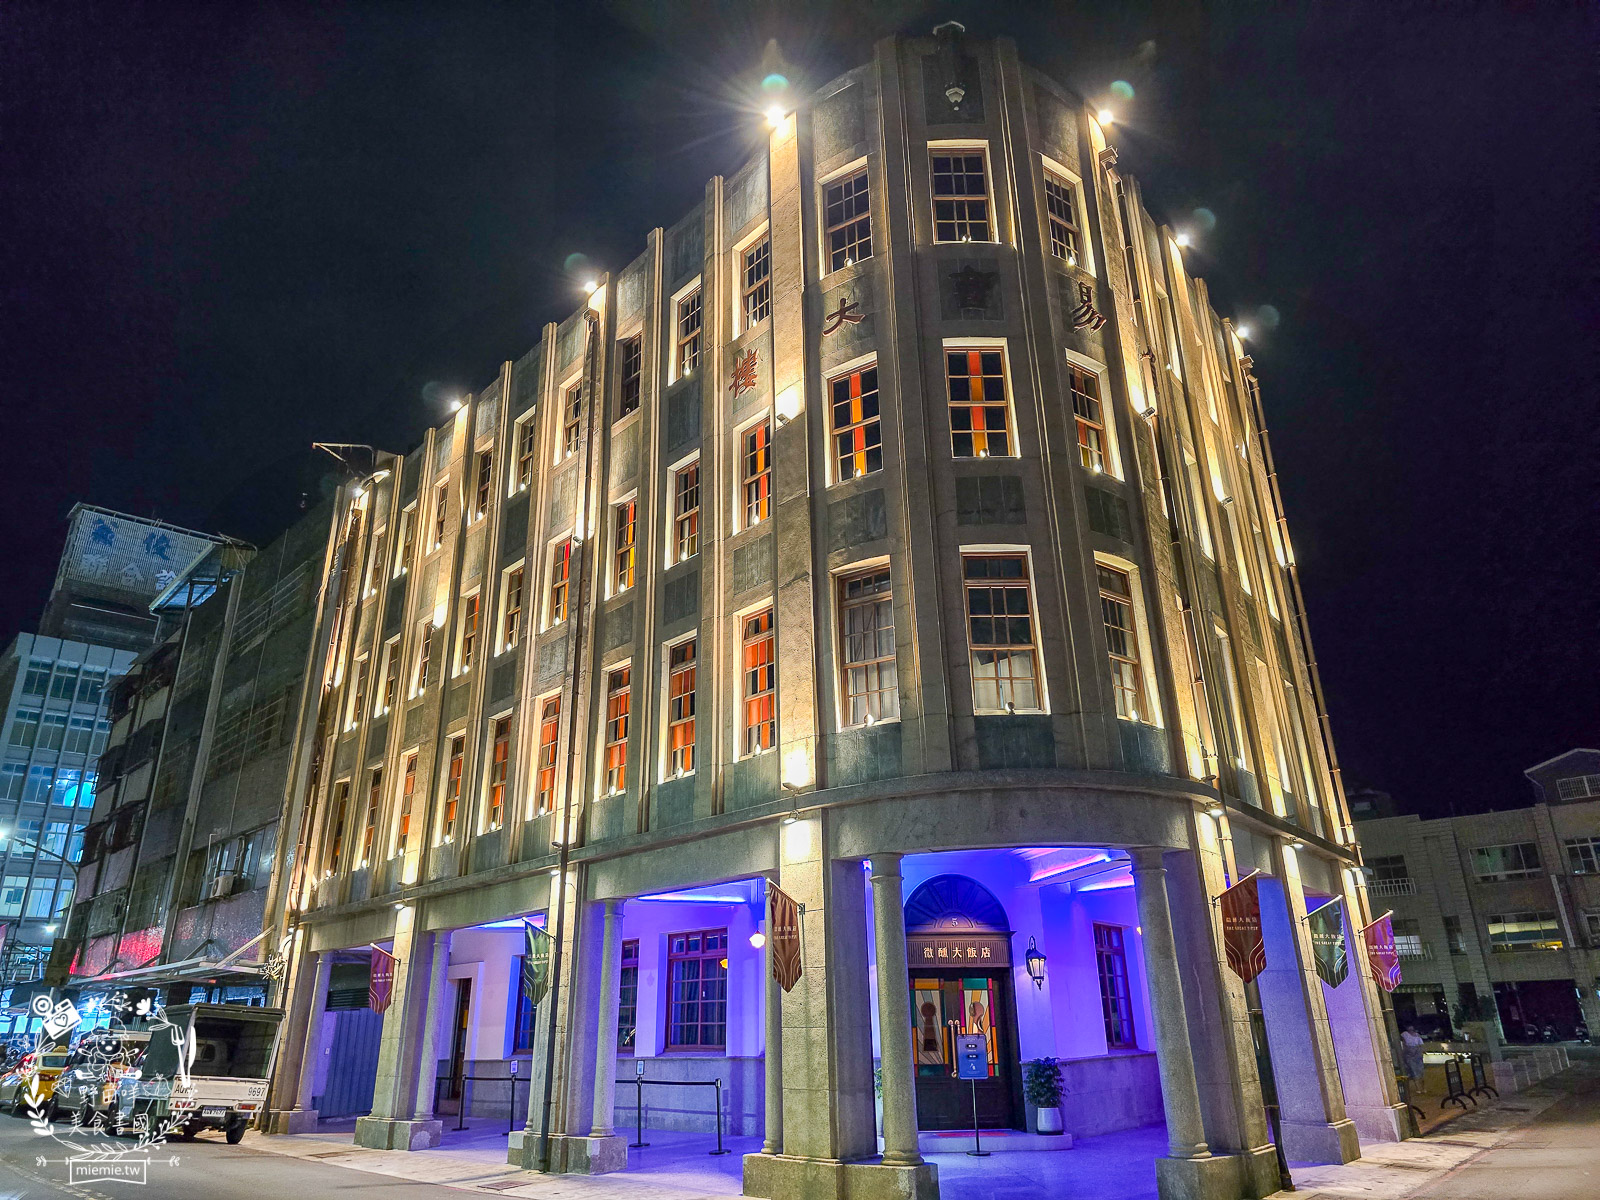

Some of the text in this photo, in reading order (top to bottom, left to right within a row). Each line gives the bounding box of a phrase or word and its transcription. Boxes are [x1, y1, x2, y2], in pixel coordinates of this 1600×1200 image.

[822, 298, 866, 337] 大
[1073, 281, 1107, 333] 易
[728, 348, 760, 400] 樓
[951, 917, 959, 928] 5
[248, 1086, 265, 1097] 9697
